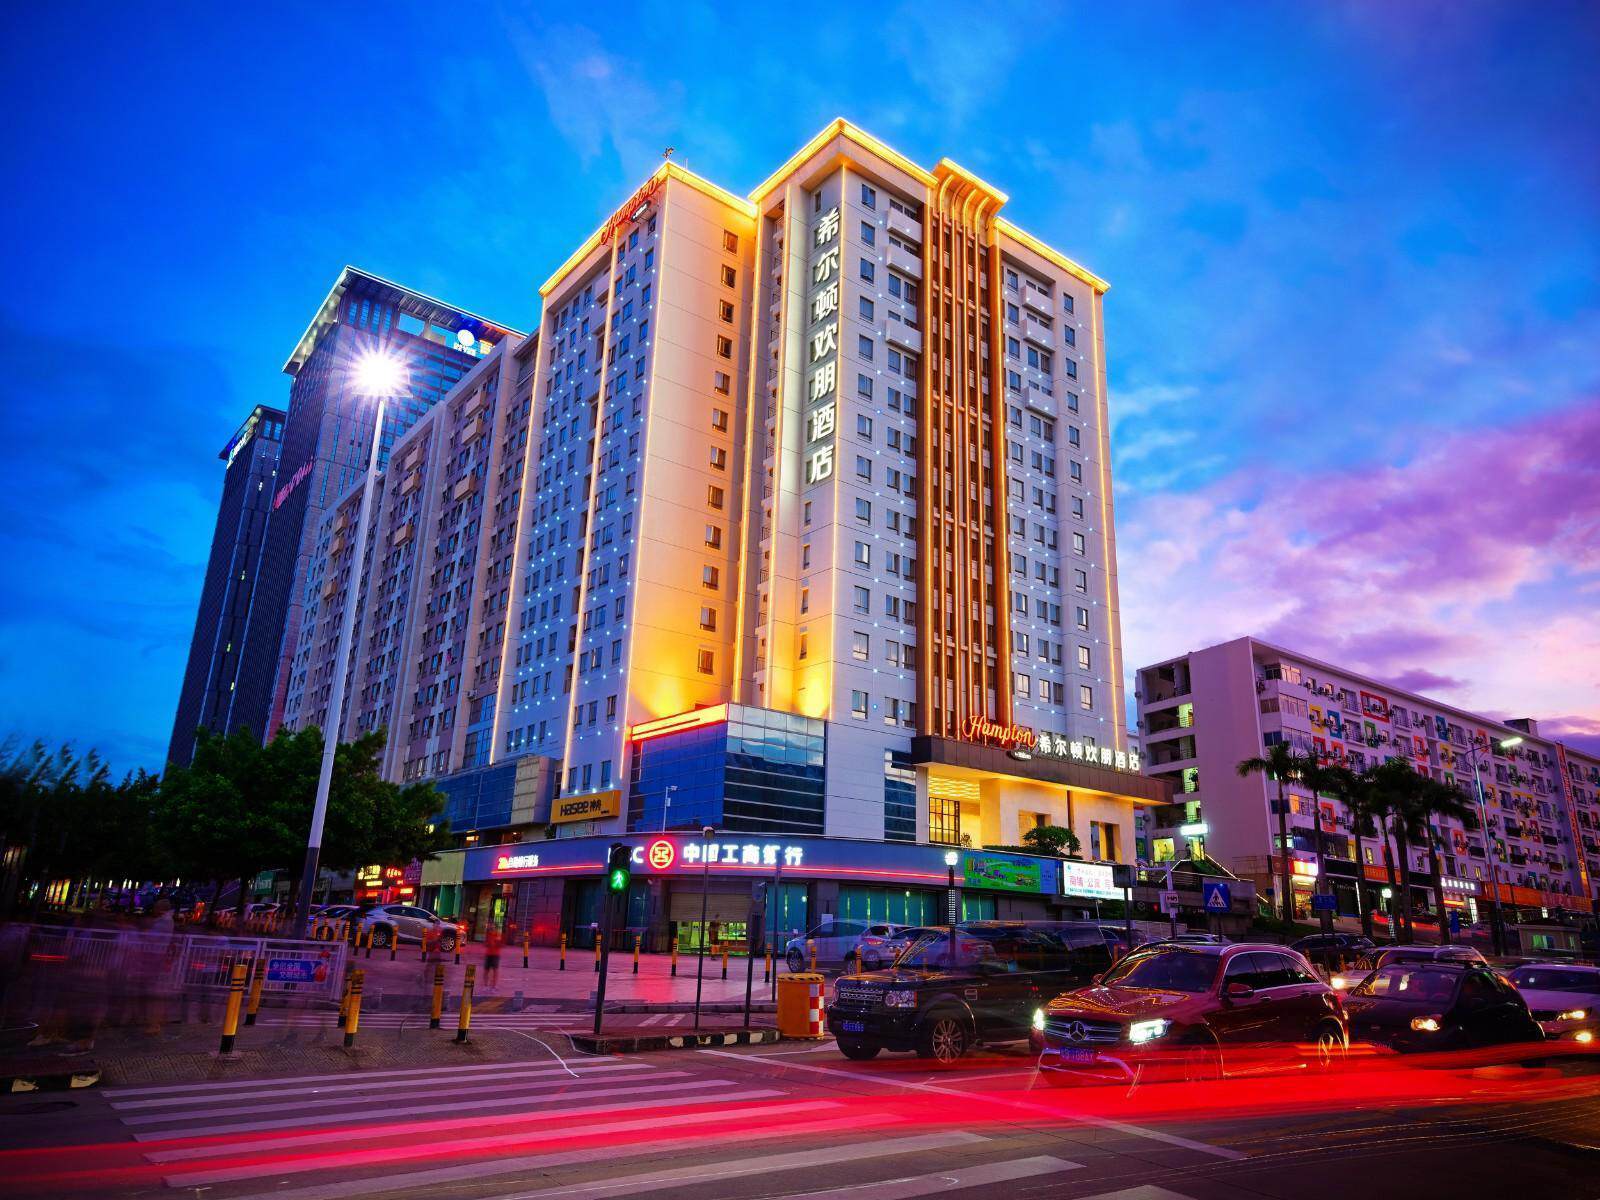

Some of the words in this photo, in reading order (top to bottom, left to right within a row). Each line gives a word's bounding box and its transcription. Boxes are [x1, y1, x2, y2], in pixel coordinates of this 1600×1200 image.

[600, 176, 658, 245] Hampton
[810, 206, 840, 484] 希尔顿欢朋酒店
[962, 715, 1038, 749] Hampton
[1038, 734, 1141, 771] 希尔顿欢朋酒店
[607, 846, 645, 864] IC
[683, 843, 803, 866] 中国工商银行
